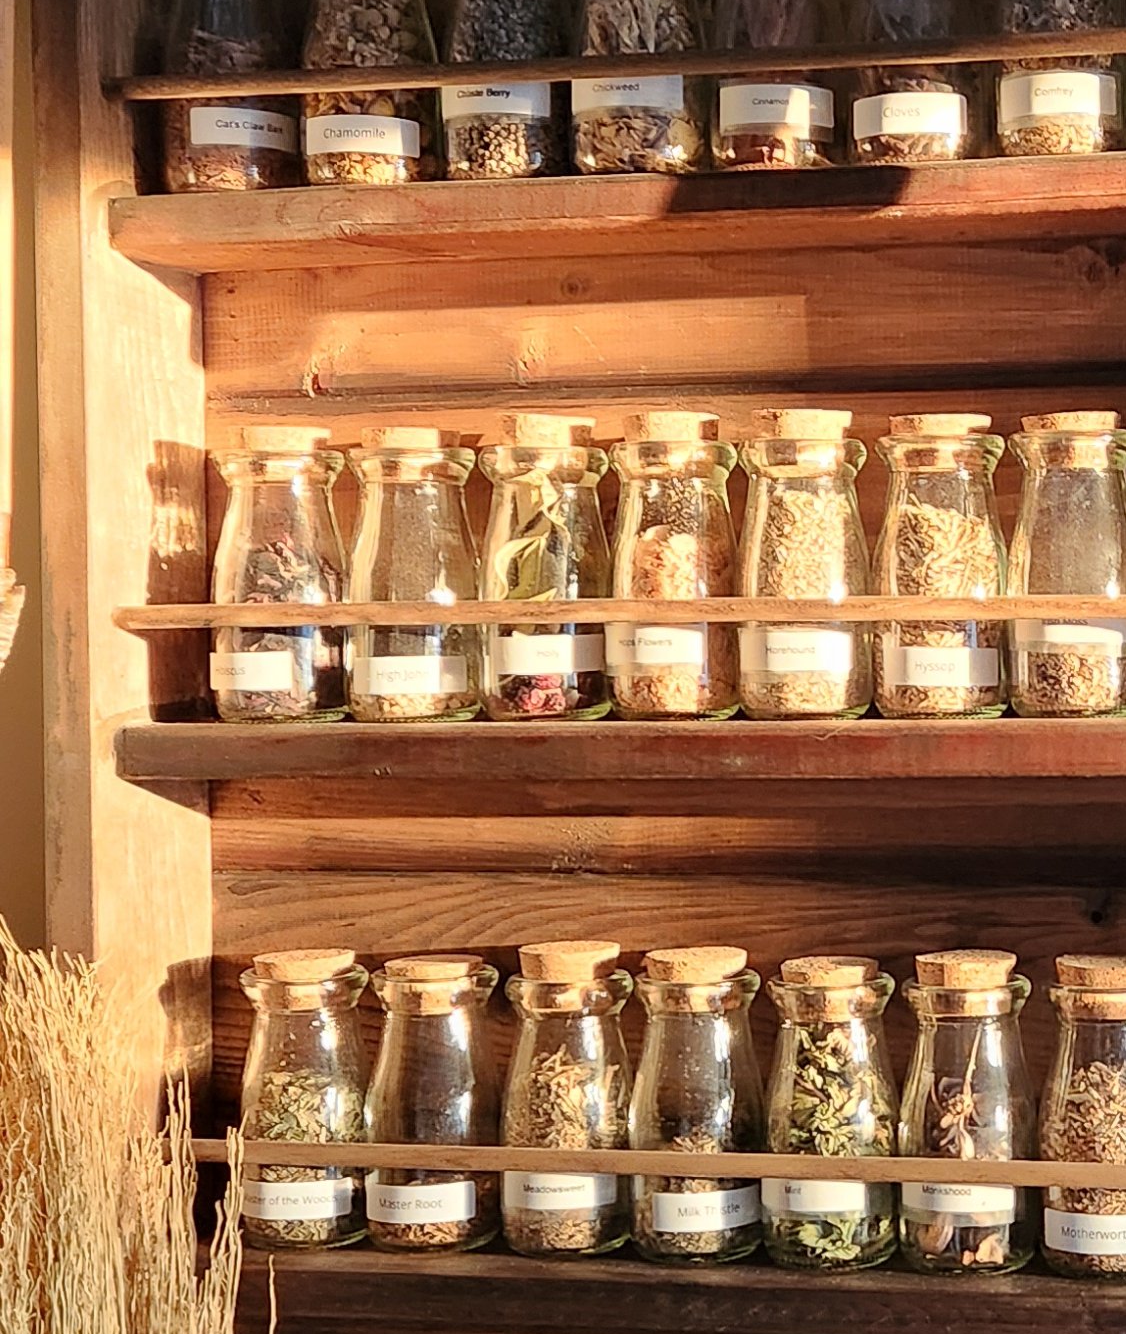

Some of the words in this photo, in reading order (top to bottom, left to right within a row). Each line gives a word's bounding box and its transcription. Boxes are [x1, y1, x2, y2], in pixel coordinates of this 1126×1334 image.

[592, 83, 640, 92] Chickweed
[1034, 87, 1074, 98] Comfrey
[486, 88, 511, 99] Berry
[752, 97, 789, 106] Cinnamon
[883, 106, 921, 119] Cloves
[215, 119, 241, 129] Cat's
[243, 121, 265, 131] Claw
[323, 127, 386, 140] Chamomile
[637, 638, 673, 647] Flowers
[765, 645, 816, 655] Horehound
[914, 661, 955, 673] Hyssop
[523, 1184, 586, 1194] Meadowsweet
[922, 1185, 972, 1196] Monkshood
[269, 1195, 281, 1205] of
[281, 1195, 300, 1205] the
[379, 1198, 412, 1210] Master
[415, 1199, 443, 1210] Root
[677, 1206, 702, 1218] Milk
[1061, 1226, 1126, 1240] Motherwort
